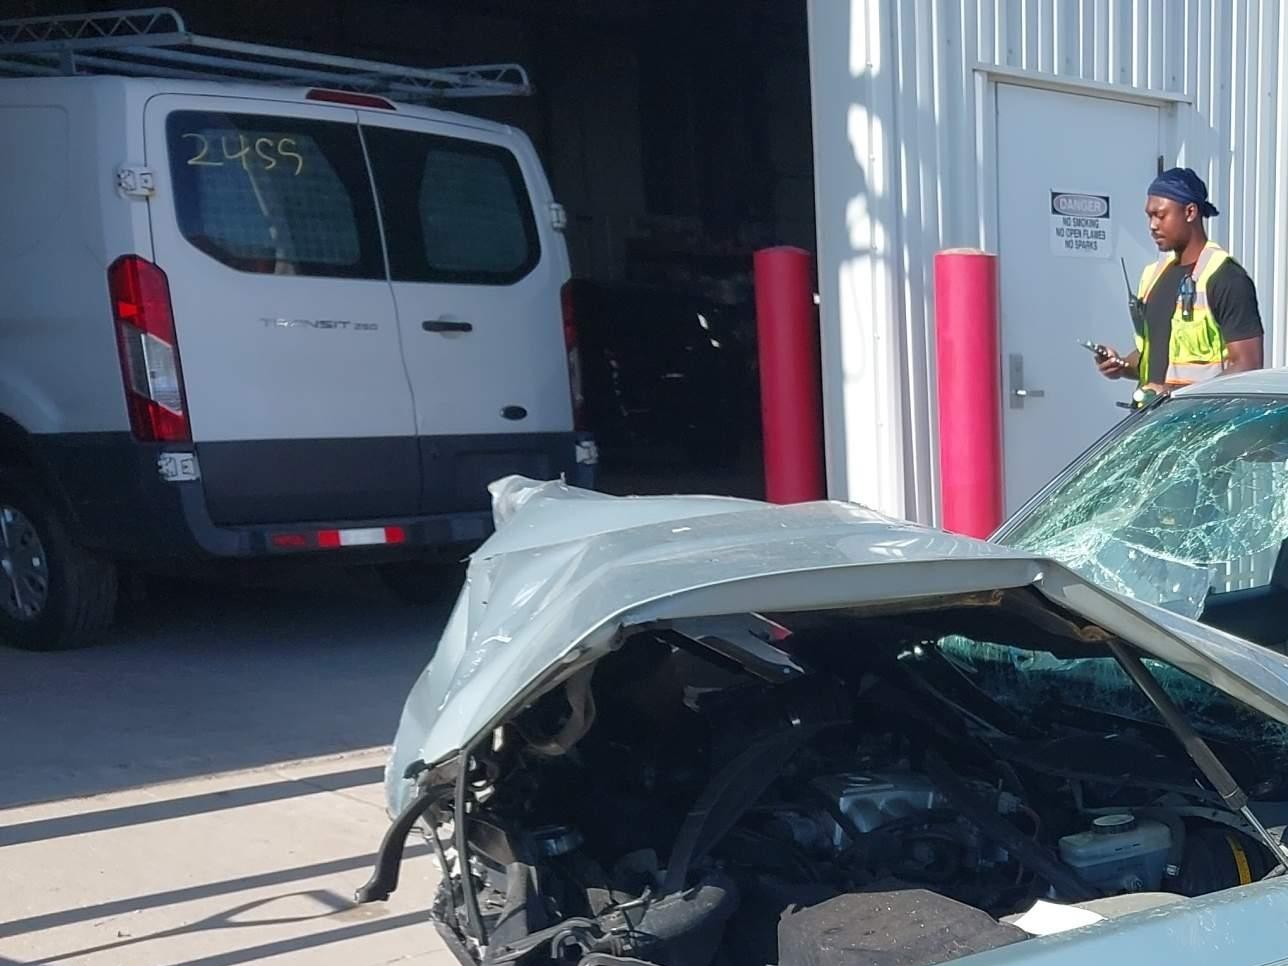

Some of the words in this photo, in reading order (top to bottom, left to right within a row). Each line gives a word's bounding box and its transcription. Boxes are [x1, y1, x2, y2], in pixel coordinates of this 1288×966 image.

[1059, 198, 1101, 213] DANGER
[1062, 217, 1072, 227] NO
[1072, 217, 1100, 229] SMOKING
[1056, 227, 1065, 238] NO
[1066, 228, 1082, 239] OPEN
[1082, 229, 1106, 240] FLAMES
[1064, 240, 1074, 249] NO
[1074, 240, 1098, 251] SPARKS
[258, 317, 351, 329] TRANSIT
